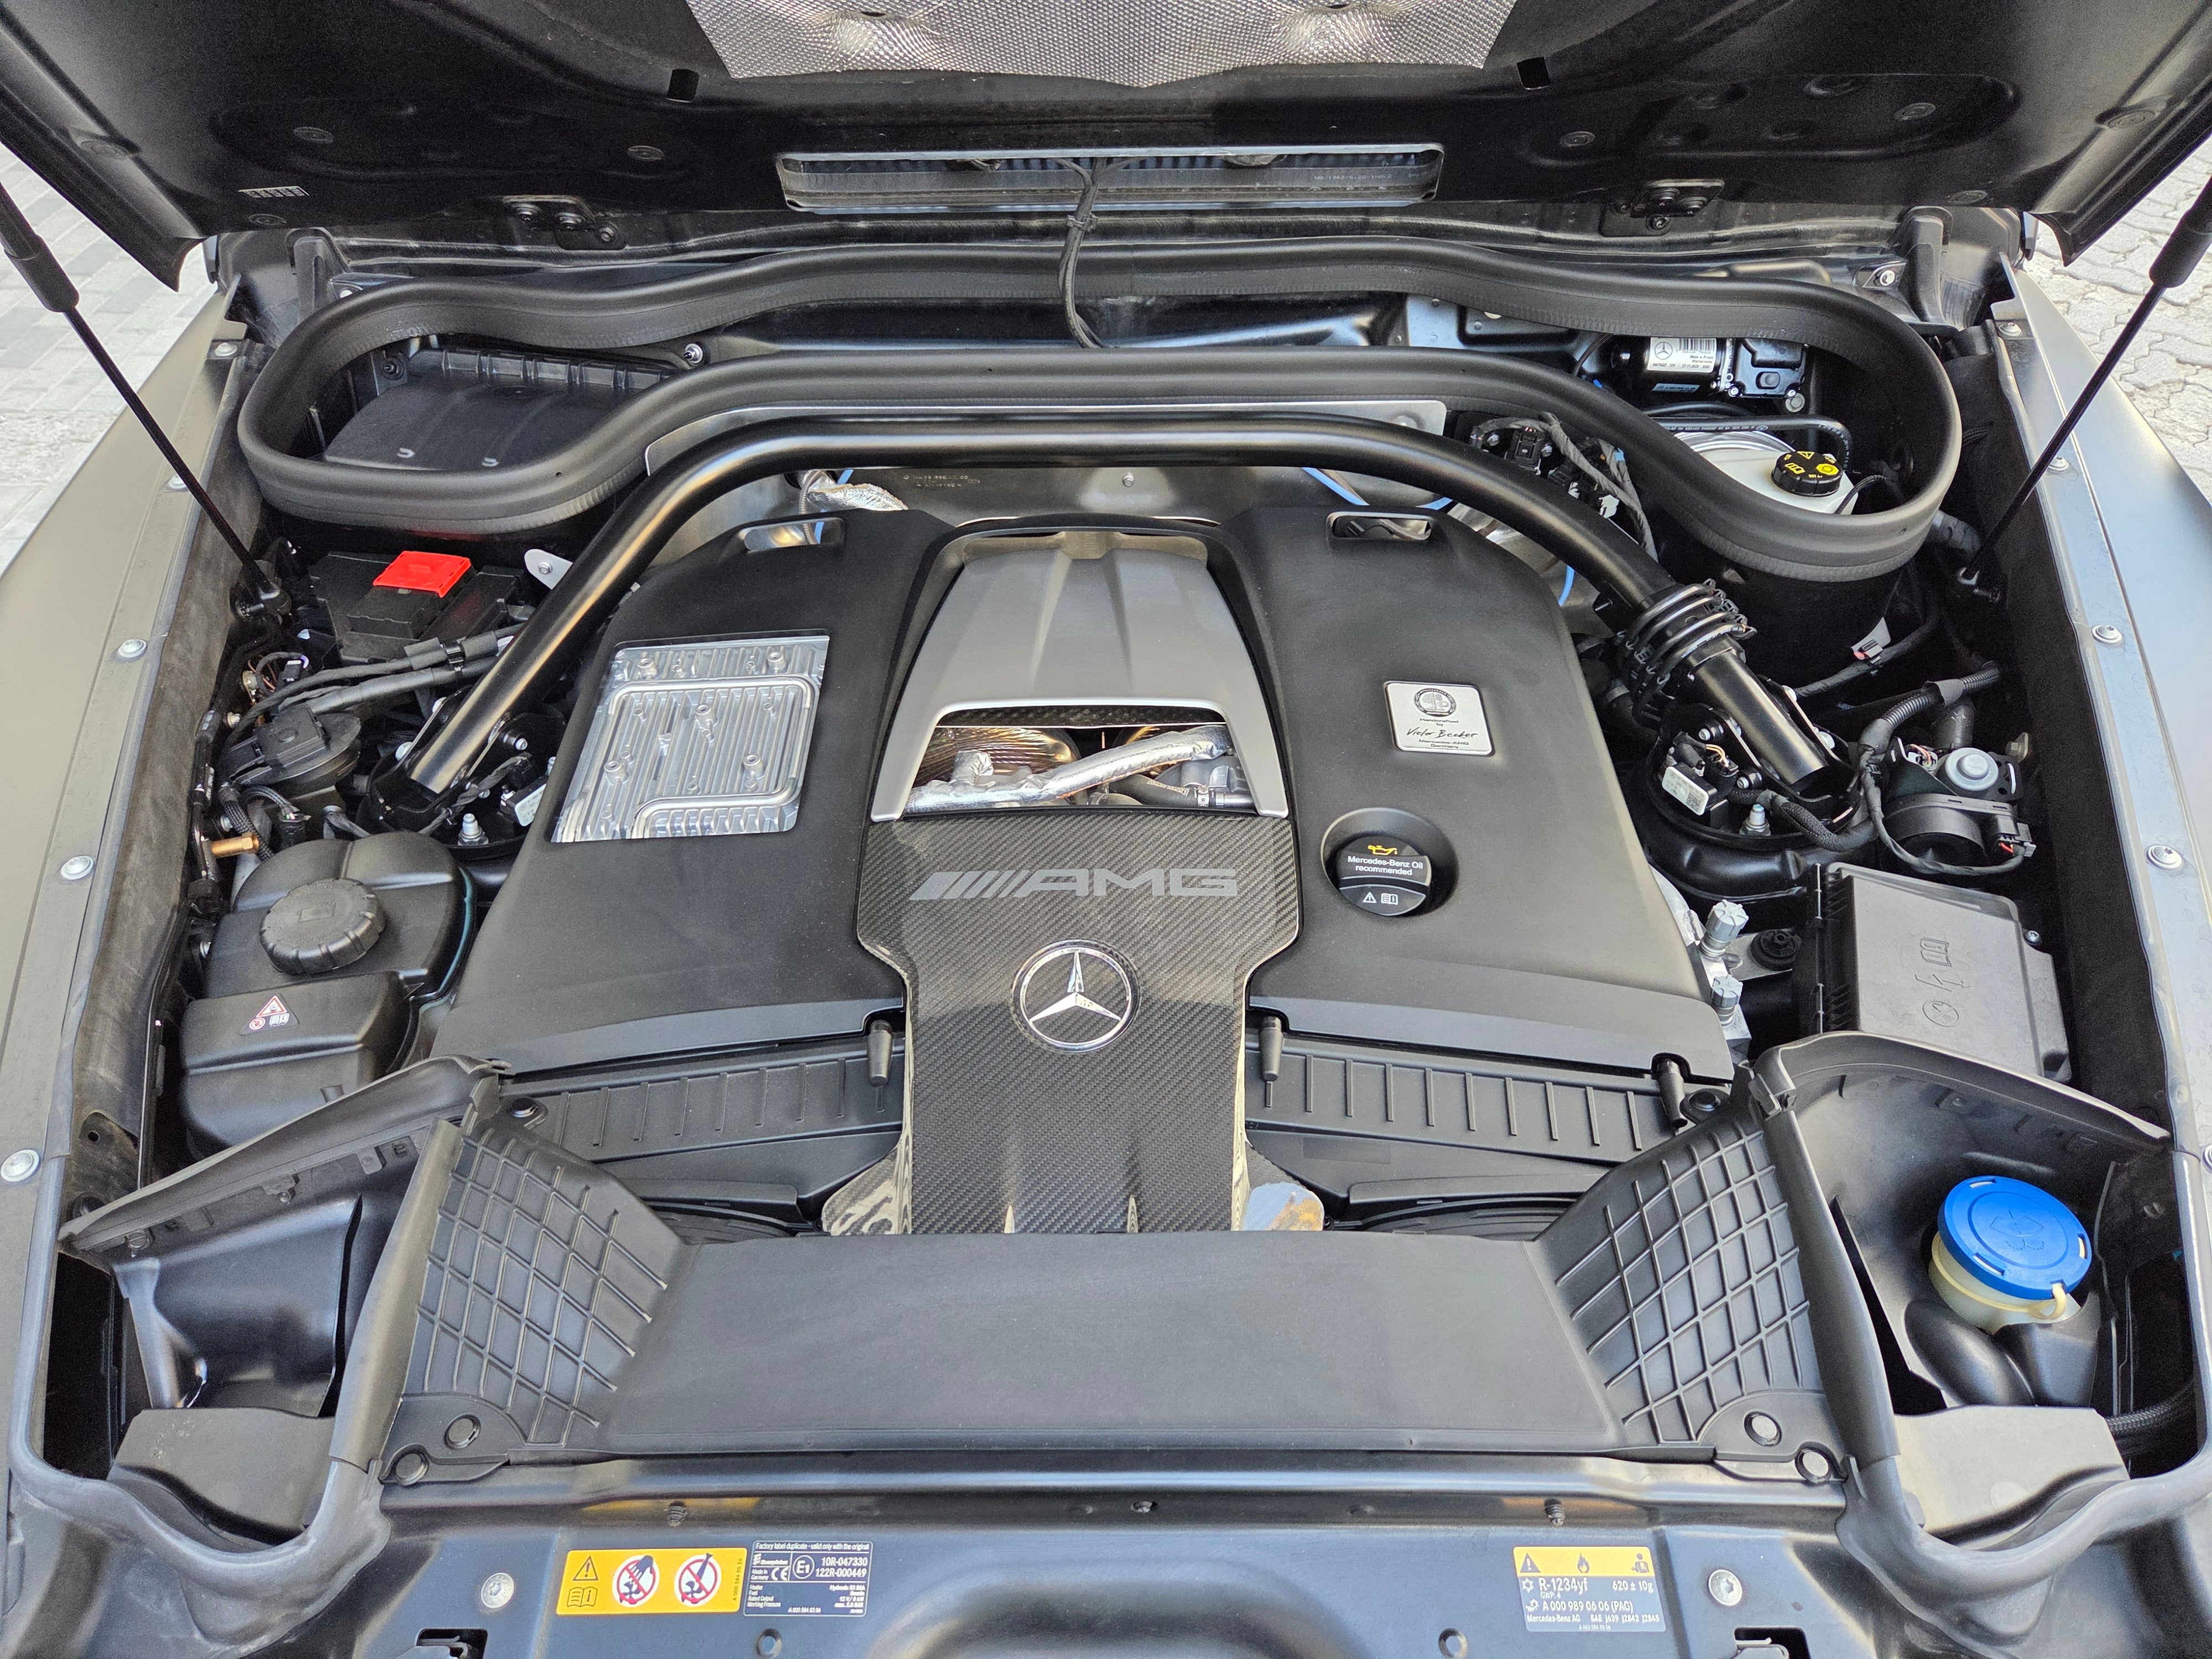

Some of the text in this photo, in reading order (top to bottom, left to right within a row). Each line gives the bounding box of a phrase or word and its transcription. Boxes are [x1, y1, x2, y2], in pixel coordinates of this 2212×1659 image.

[1348, 856, 1410, 867] Mercedes-Benz
[1355, 865, 1412, 875] recommended
[1013, 868, 1238, 898] AMG
[796, 1560, 810, 1573] E1
[821, 1557, 868, 1566] 10R-047330
[815, 1567, 867, 1577] 122R-000449
[1538, 1577, 1588, 1595] R-1234yf
[1612, 1580, 1629, 1591] 620
[1638, 1580, 1654, 1593] 10g
[1542, 1600, 1634, 1614] A 000 989 06 06 (PAG)
[1527, 1614, 1572, 1623] Mercedes-Benz
[1572, 1614, 1580, 1623] AG
[1590, 1614, 1603, 1623] SAE
